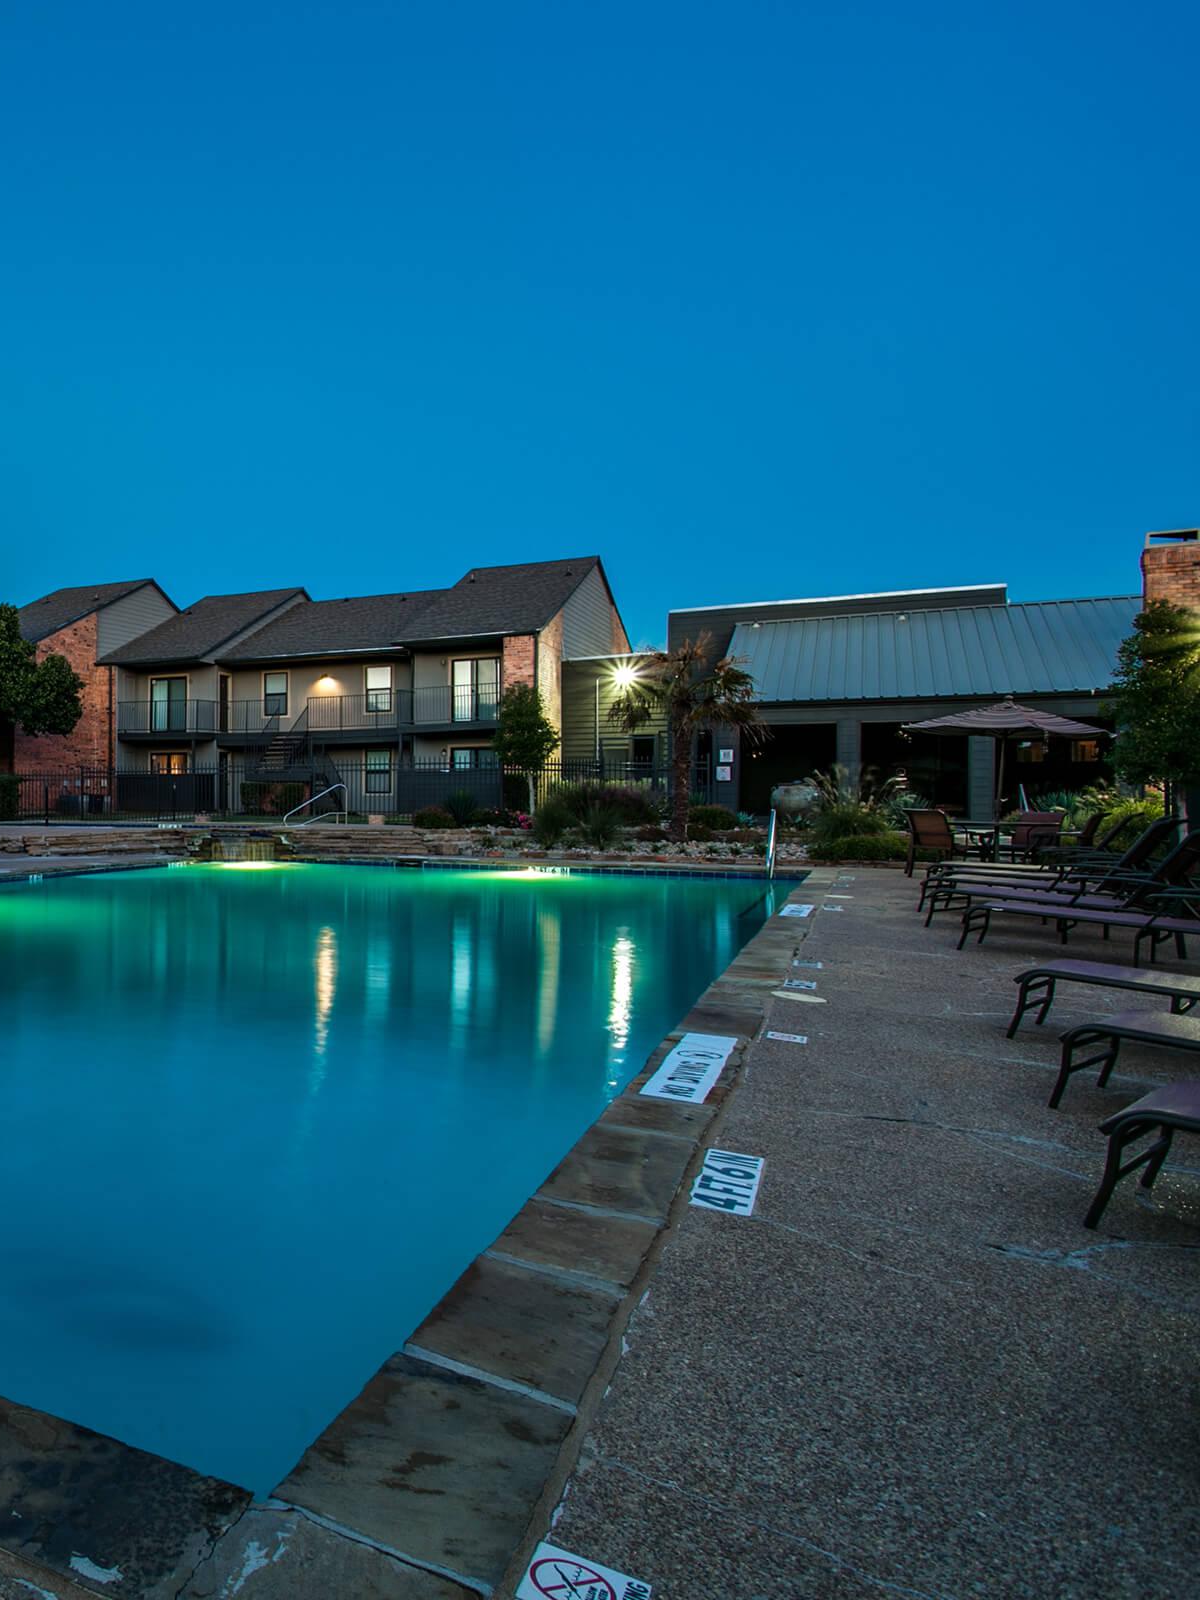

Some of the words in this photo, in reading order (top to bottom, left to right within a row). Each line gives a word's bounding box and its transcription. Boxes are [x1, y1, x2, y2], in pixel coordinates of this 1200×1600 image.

[667, 1060, 711, 1084] DIVING
[659, 1083, 697, 1098] NO
[708, 1150, 760, 1169] IN
[704, 1163, 756, 1180] 6
[692, 1192, 749, 1210] 4
